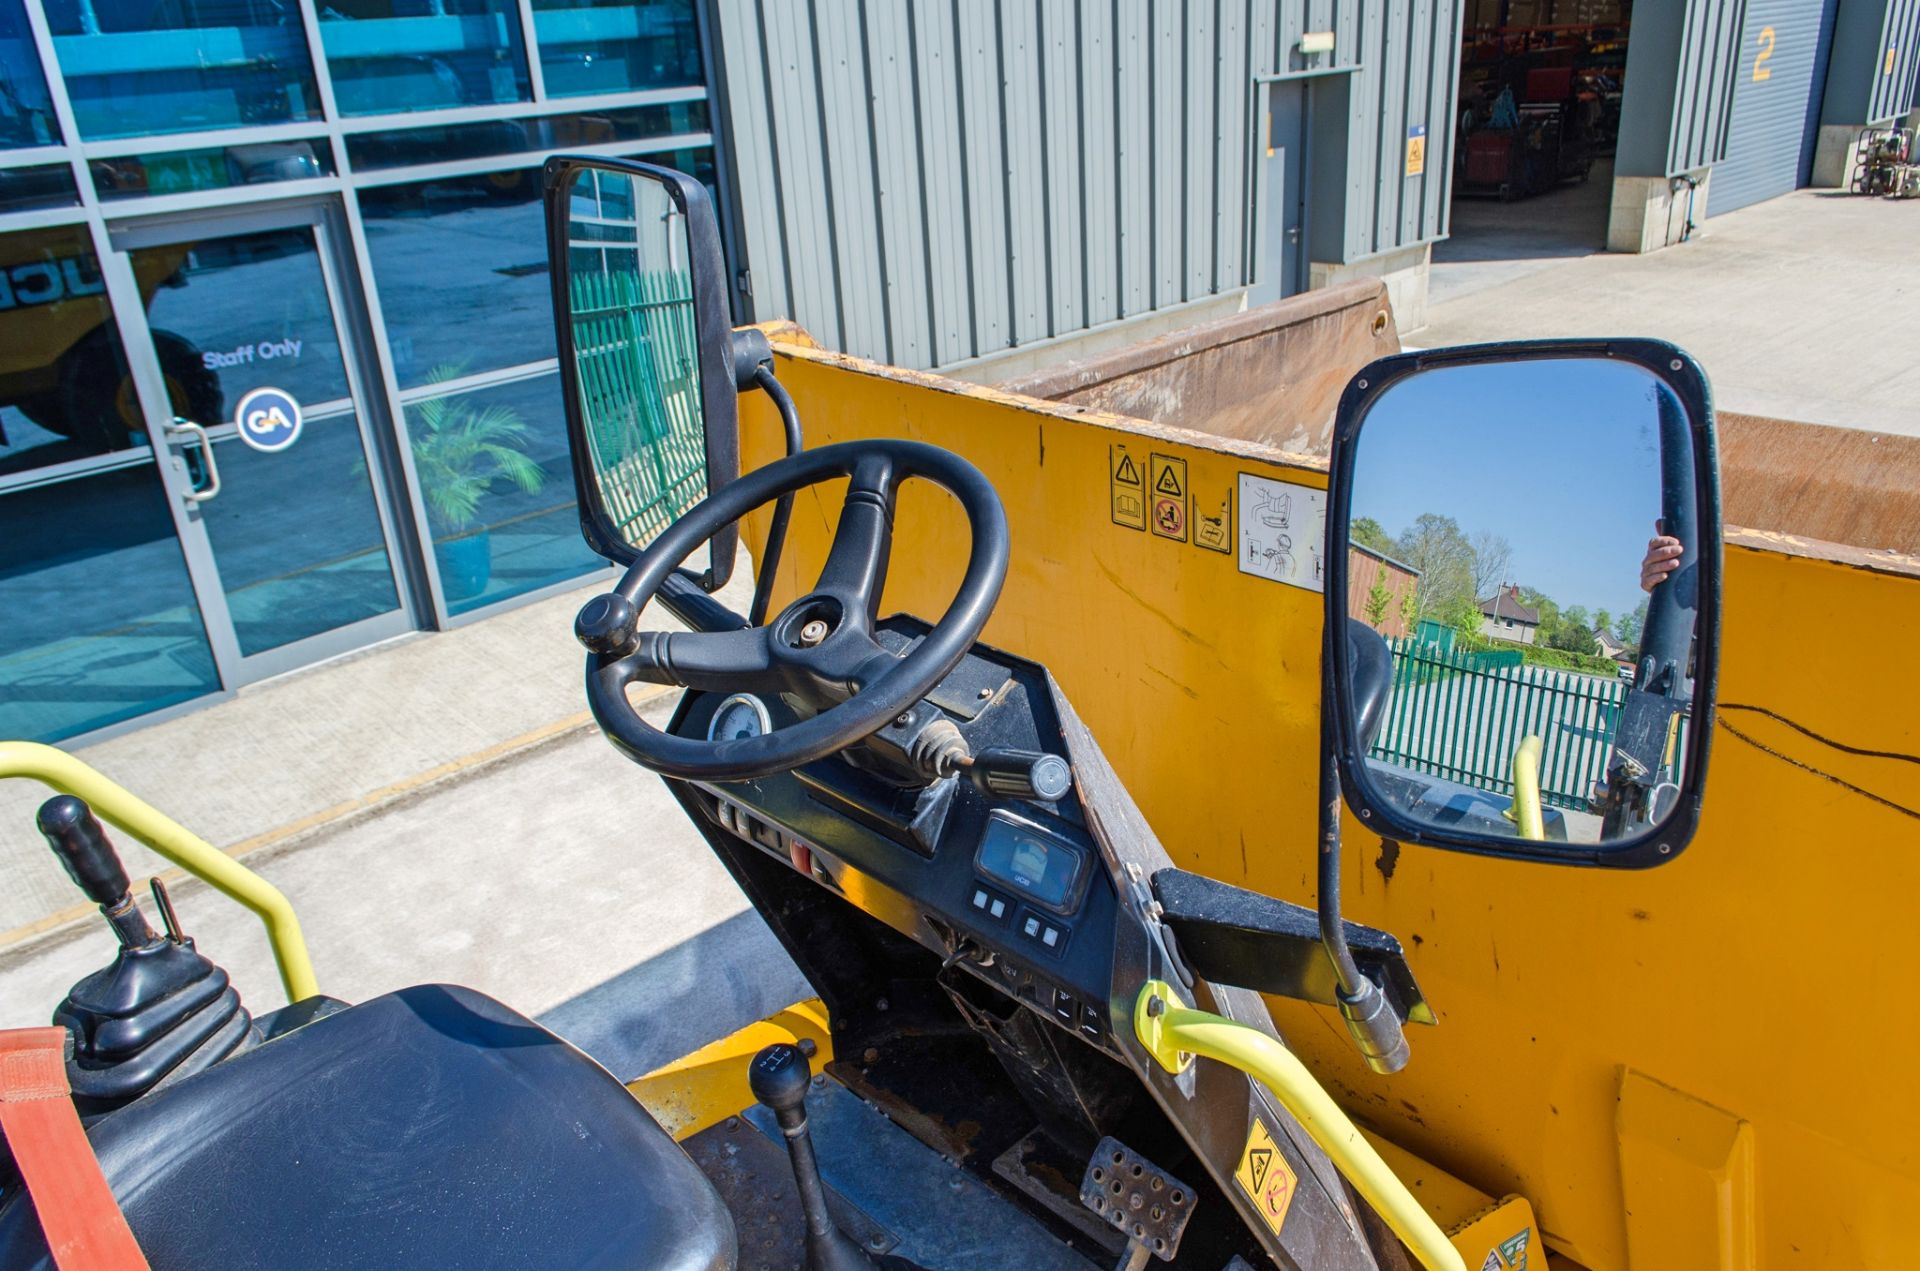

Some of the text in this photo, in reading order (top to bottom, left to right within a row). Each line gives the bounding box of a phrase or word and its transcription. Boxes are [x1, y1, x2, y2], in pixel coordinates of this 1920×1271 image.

[1752, 26, 1776, 81] 2
[202, 338, 302, 369] Staff Only
[247, 406, 292, 434] GA
